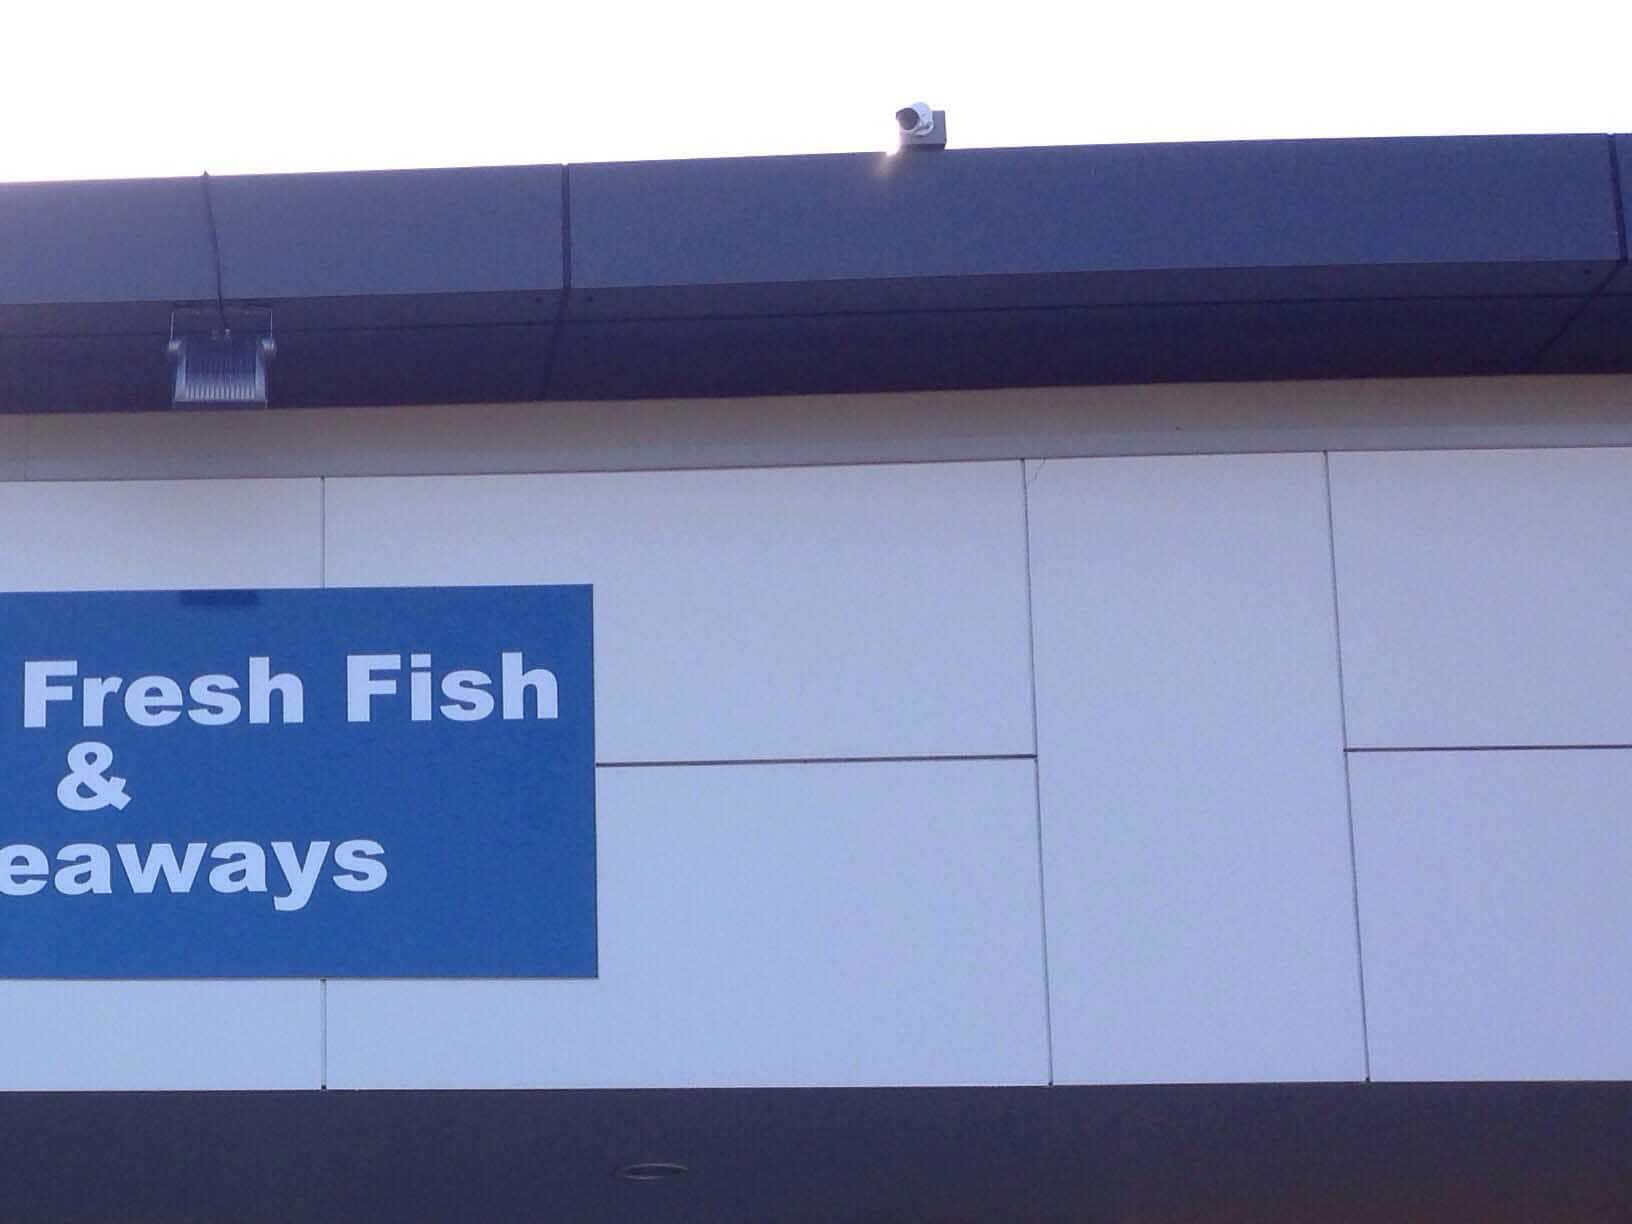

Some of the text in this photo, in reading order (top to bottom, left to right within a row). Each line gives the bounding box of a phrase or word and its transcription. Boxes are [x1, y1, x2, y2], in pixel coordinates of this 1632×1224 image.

[23, 656, 304, 728] Fresh
[346, 652, 558, 722] Fish
[56, 741, 131, 811] &
